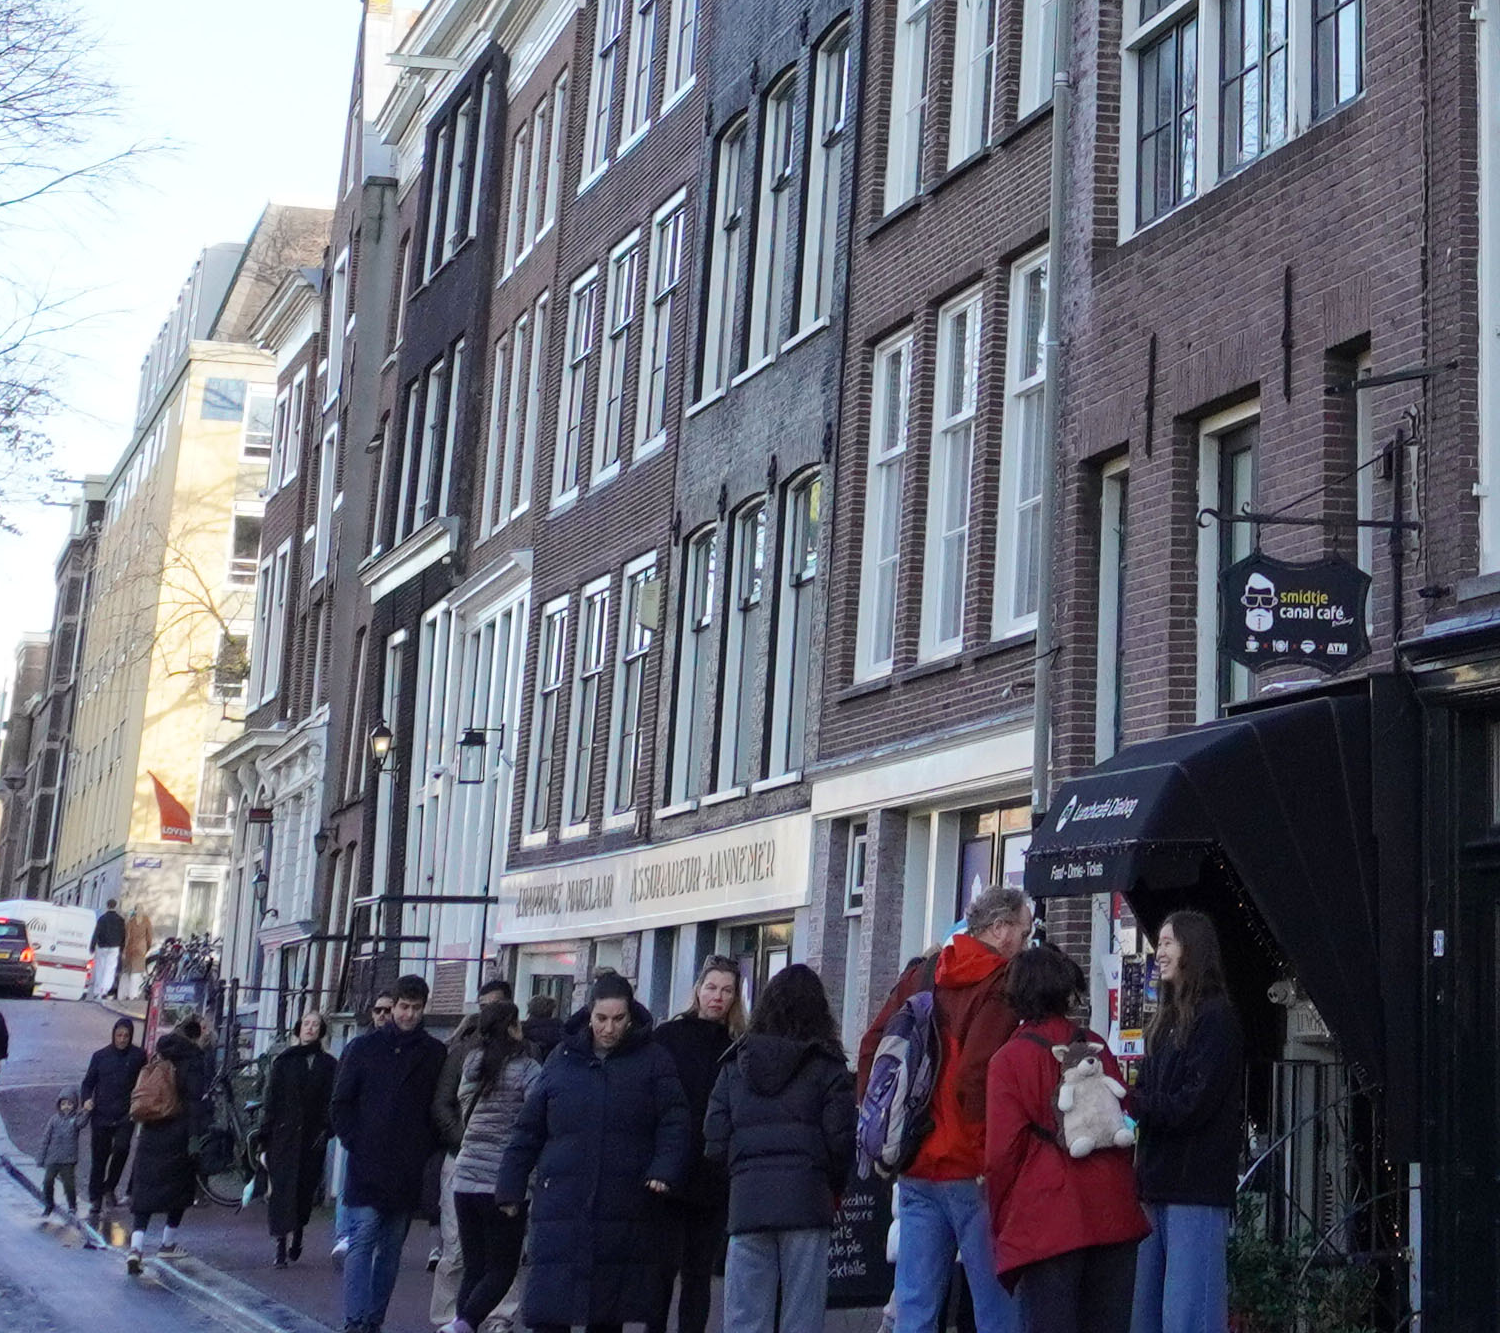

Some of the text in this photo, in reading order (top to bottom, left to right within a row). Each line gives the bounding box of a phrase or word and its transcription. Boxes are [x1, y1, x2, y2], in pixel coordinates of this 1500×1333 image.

[1279, 589, 1329, 606] smidtje
[1279, 604, 1344, 620] canal café
[1327, 642, 1348, 654] ATM
